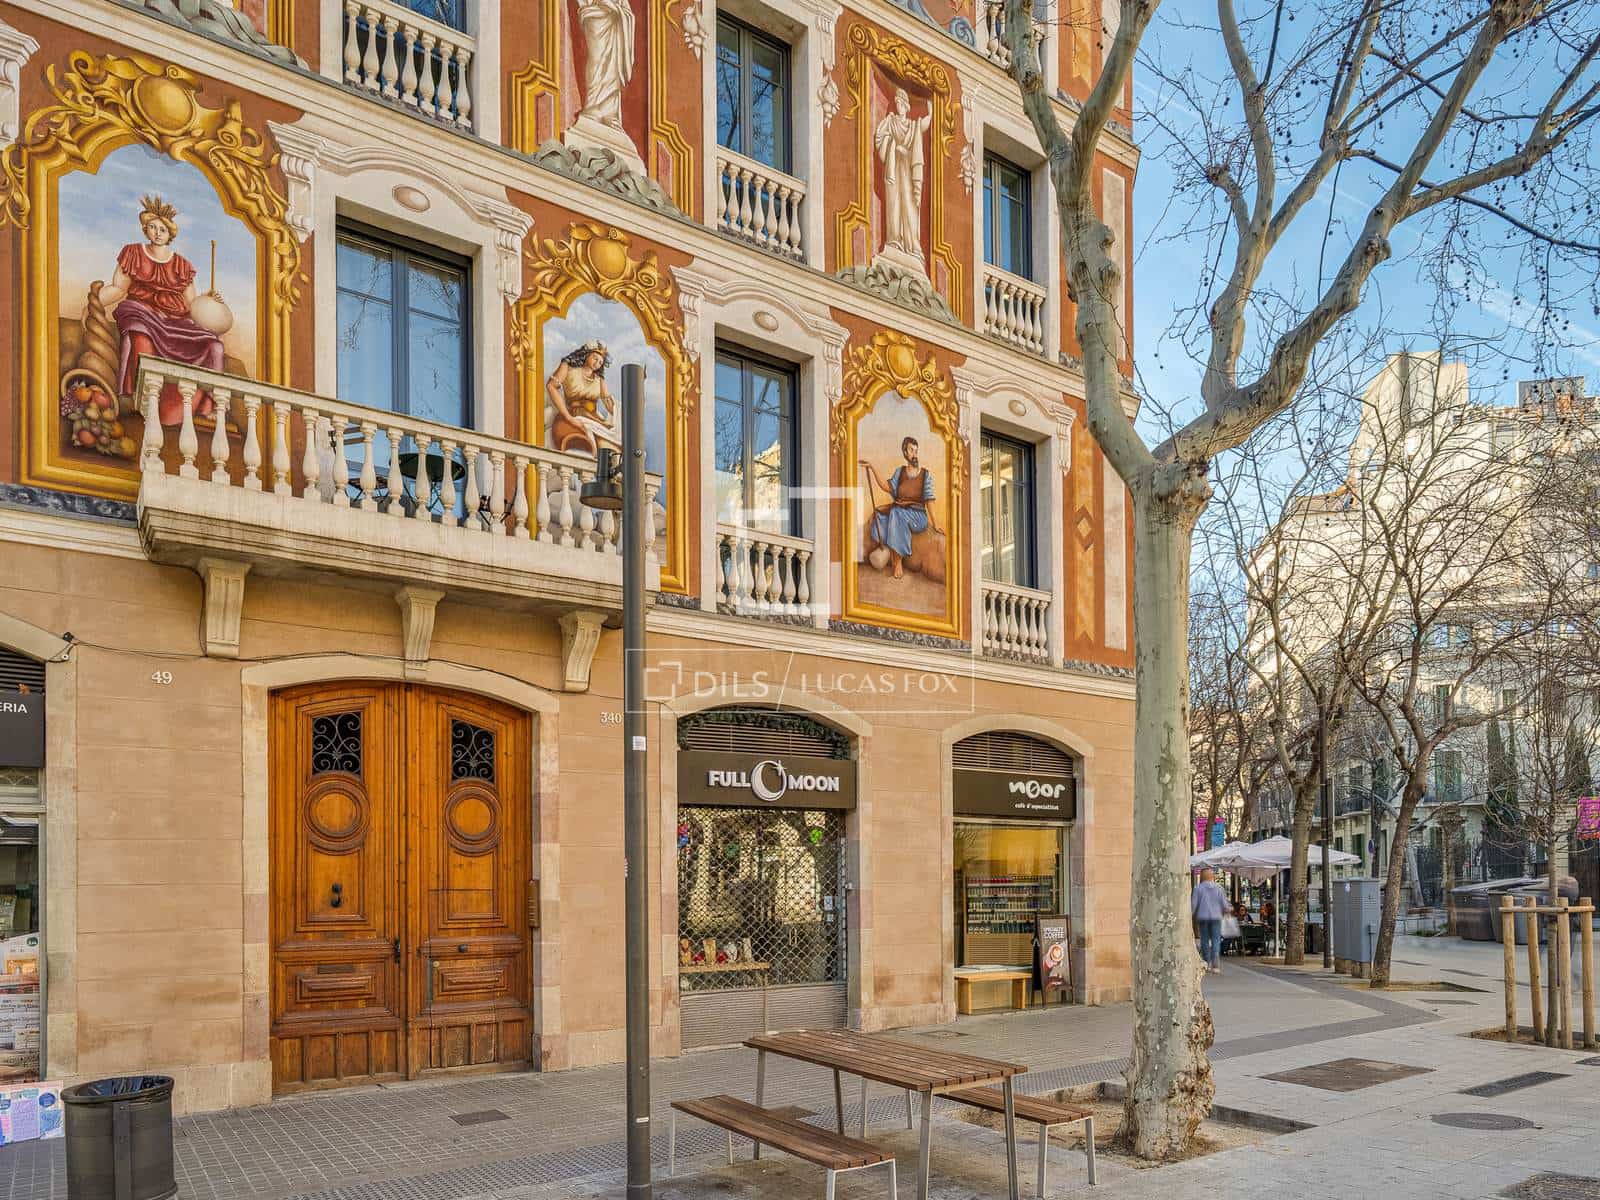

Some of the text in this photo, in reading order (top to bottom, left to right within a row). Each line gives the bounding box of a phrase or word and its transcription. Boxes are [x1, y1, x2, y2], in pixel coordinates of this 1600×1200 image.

[151, 671, 173, 685] 49
[708, 769, 840, 792] FULL MOON
